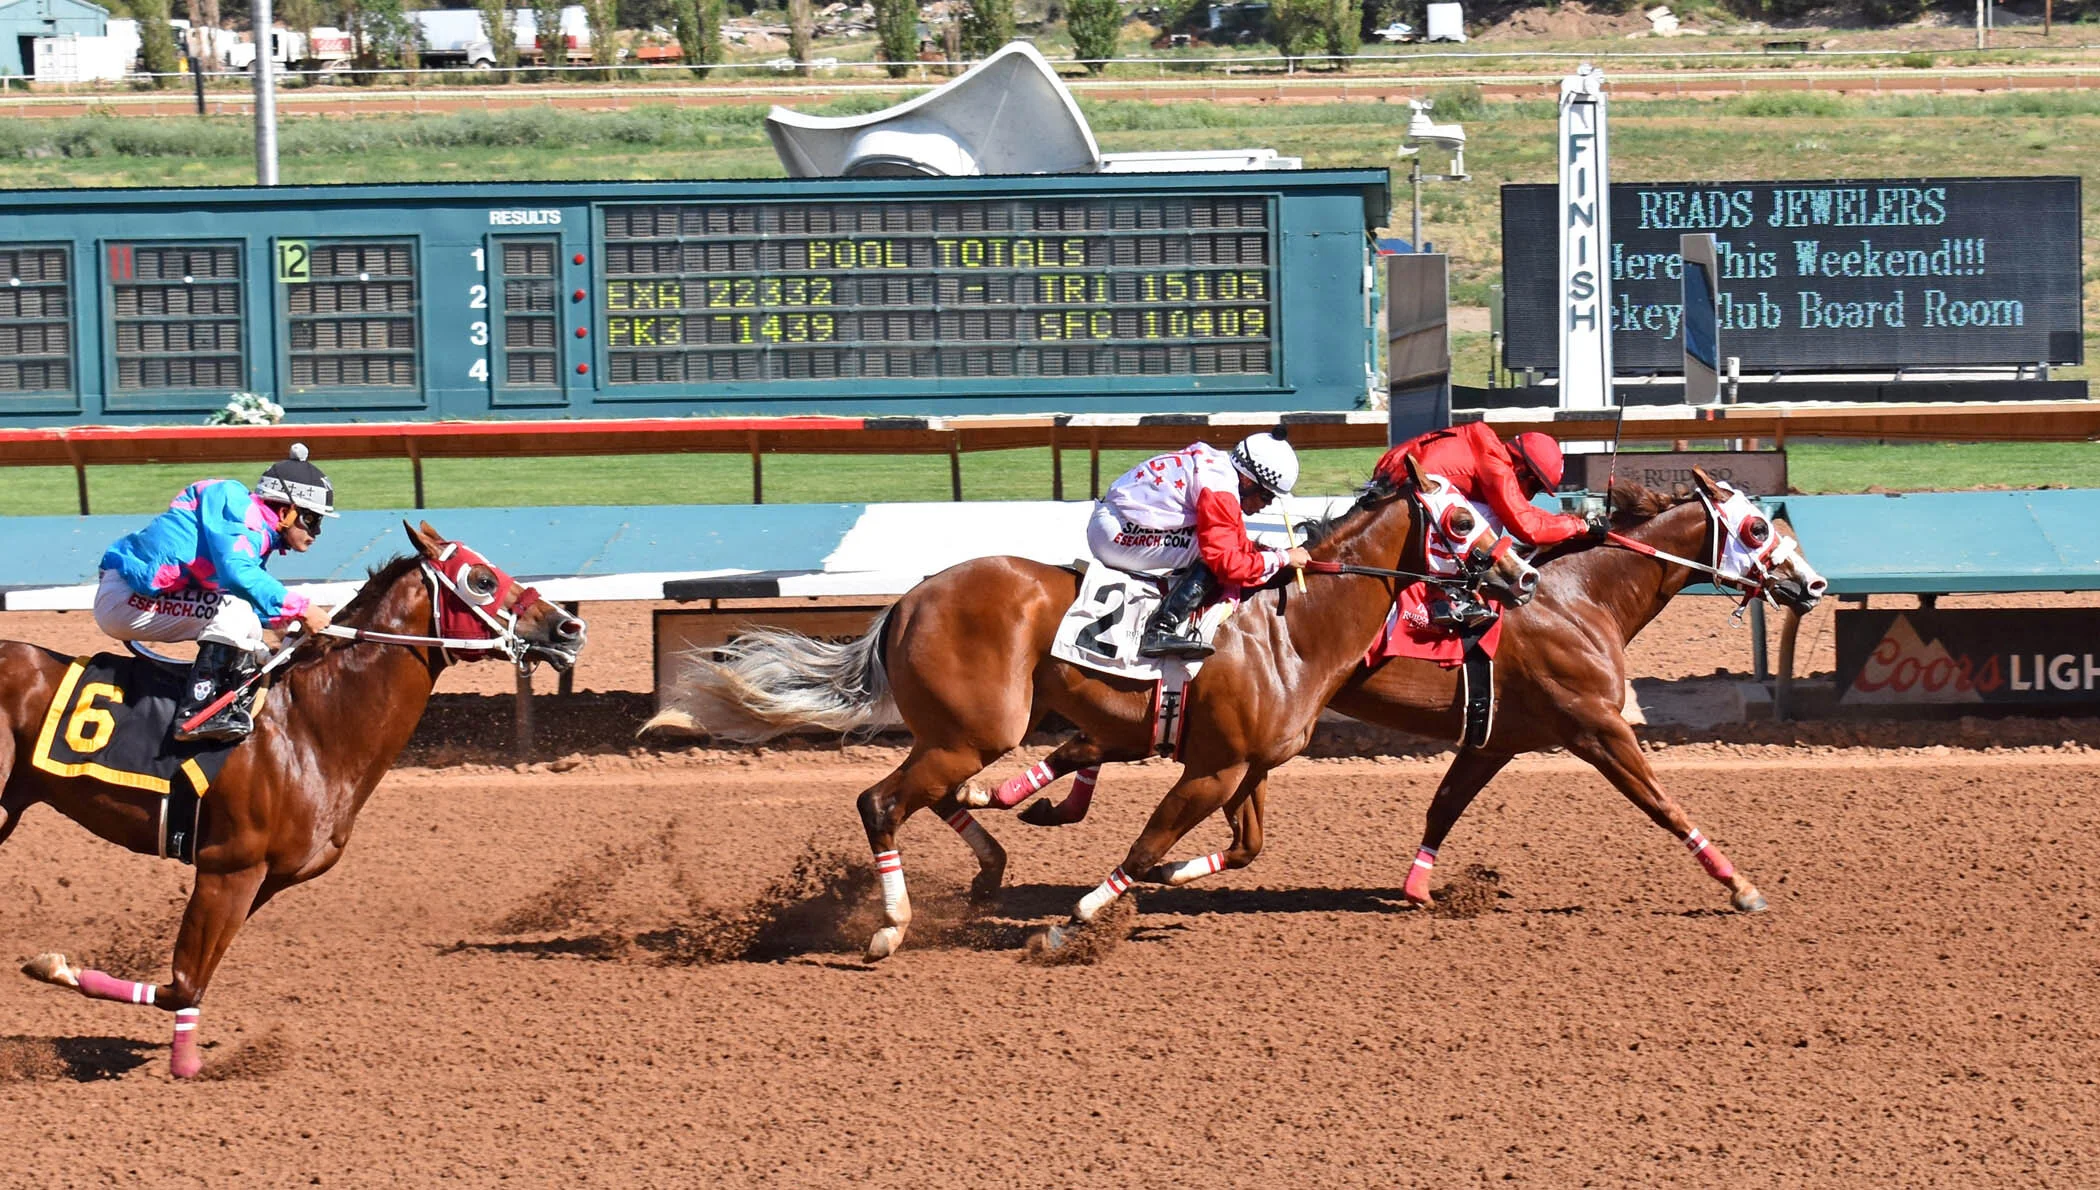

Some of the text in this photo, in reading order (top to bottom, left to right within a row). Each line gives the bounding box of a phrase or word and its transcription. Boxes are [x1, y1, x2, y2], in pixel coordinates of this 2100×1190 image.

[489, 210, 561, 225] RESULTS
[1637, 188, 1946, 229] READS JEWELERS
[1568, 133, 1597, 332] FINISH
[109, 246, 132, 281] 11
[278, 244, 307, 279] 12
[471, 248, 486, 272] 1
[809, 239, 1085, 269] POOL TOTALS
[1792, 238, 1985, 278] Weekend!!!
[470, 285, 488, 309] 2
[607, 272, 1264, 309] EXA 22332 TRI 15105
[608, 317, 682, 347] PK3
[1040, 311, 1112, 341] SFC
[1145, 308, 1265, 338] 10409
[1797, 290, 1906, 329] Board
[1922, 290, 2024, 327] Room
[470, 321, 489, 346] 3
[469, 358, 489, 382] 4
[1644, 468, 1732, 487] RUIDSO
[1075, 583, 1126, 659] 2
[1854, 637, 2006, 693] Coors
[64, 682, 124, 753] 6
